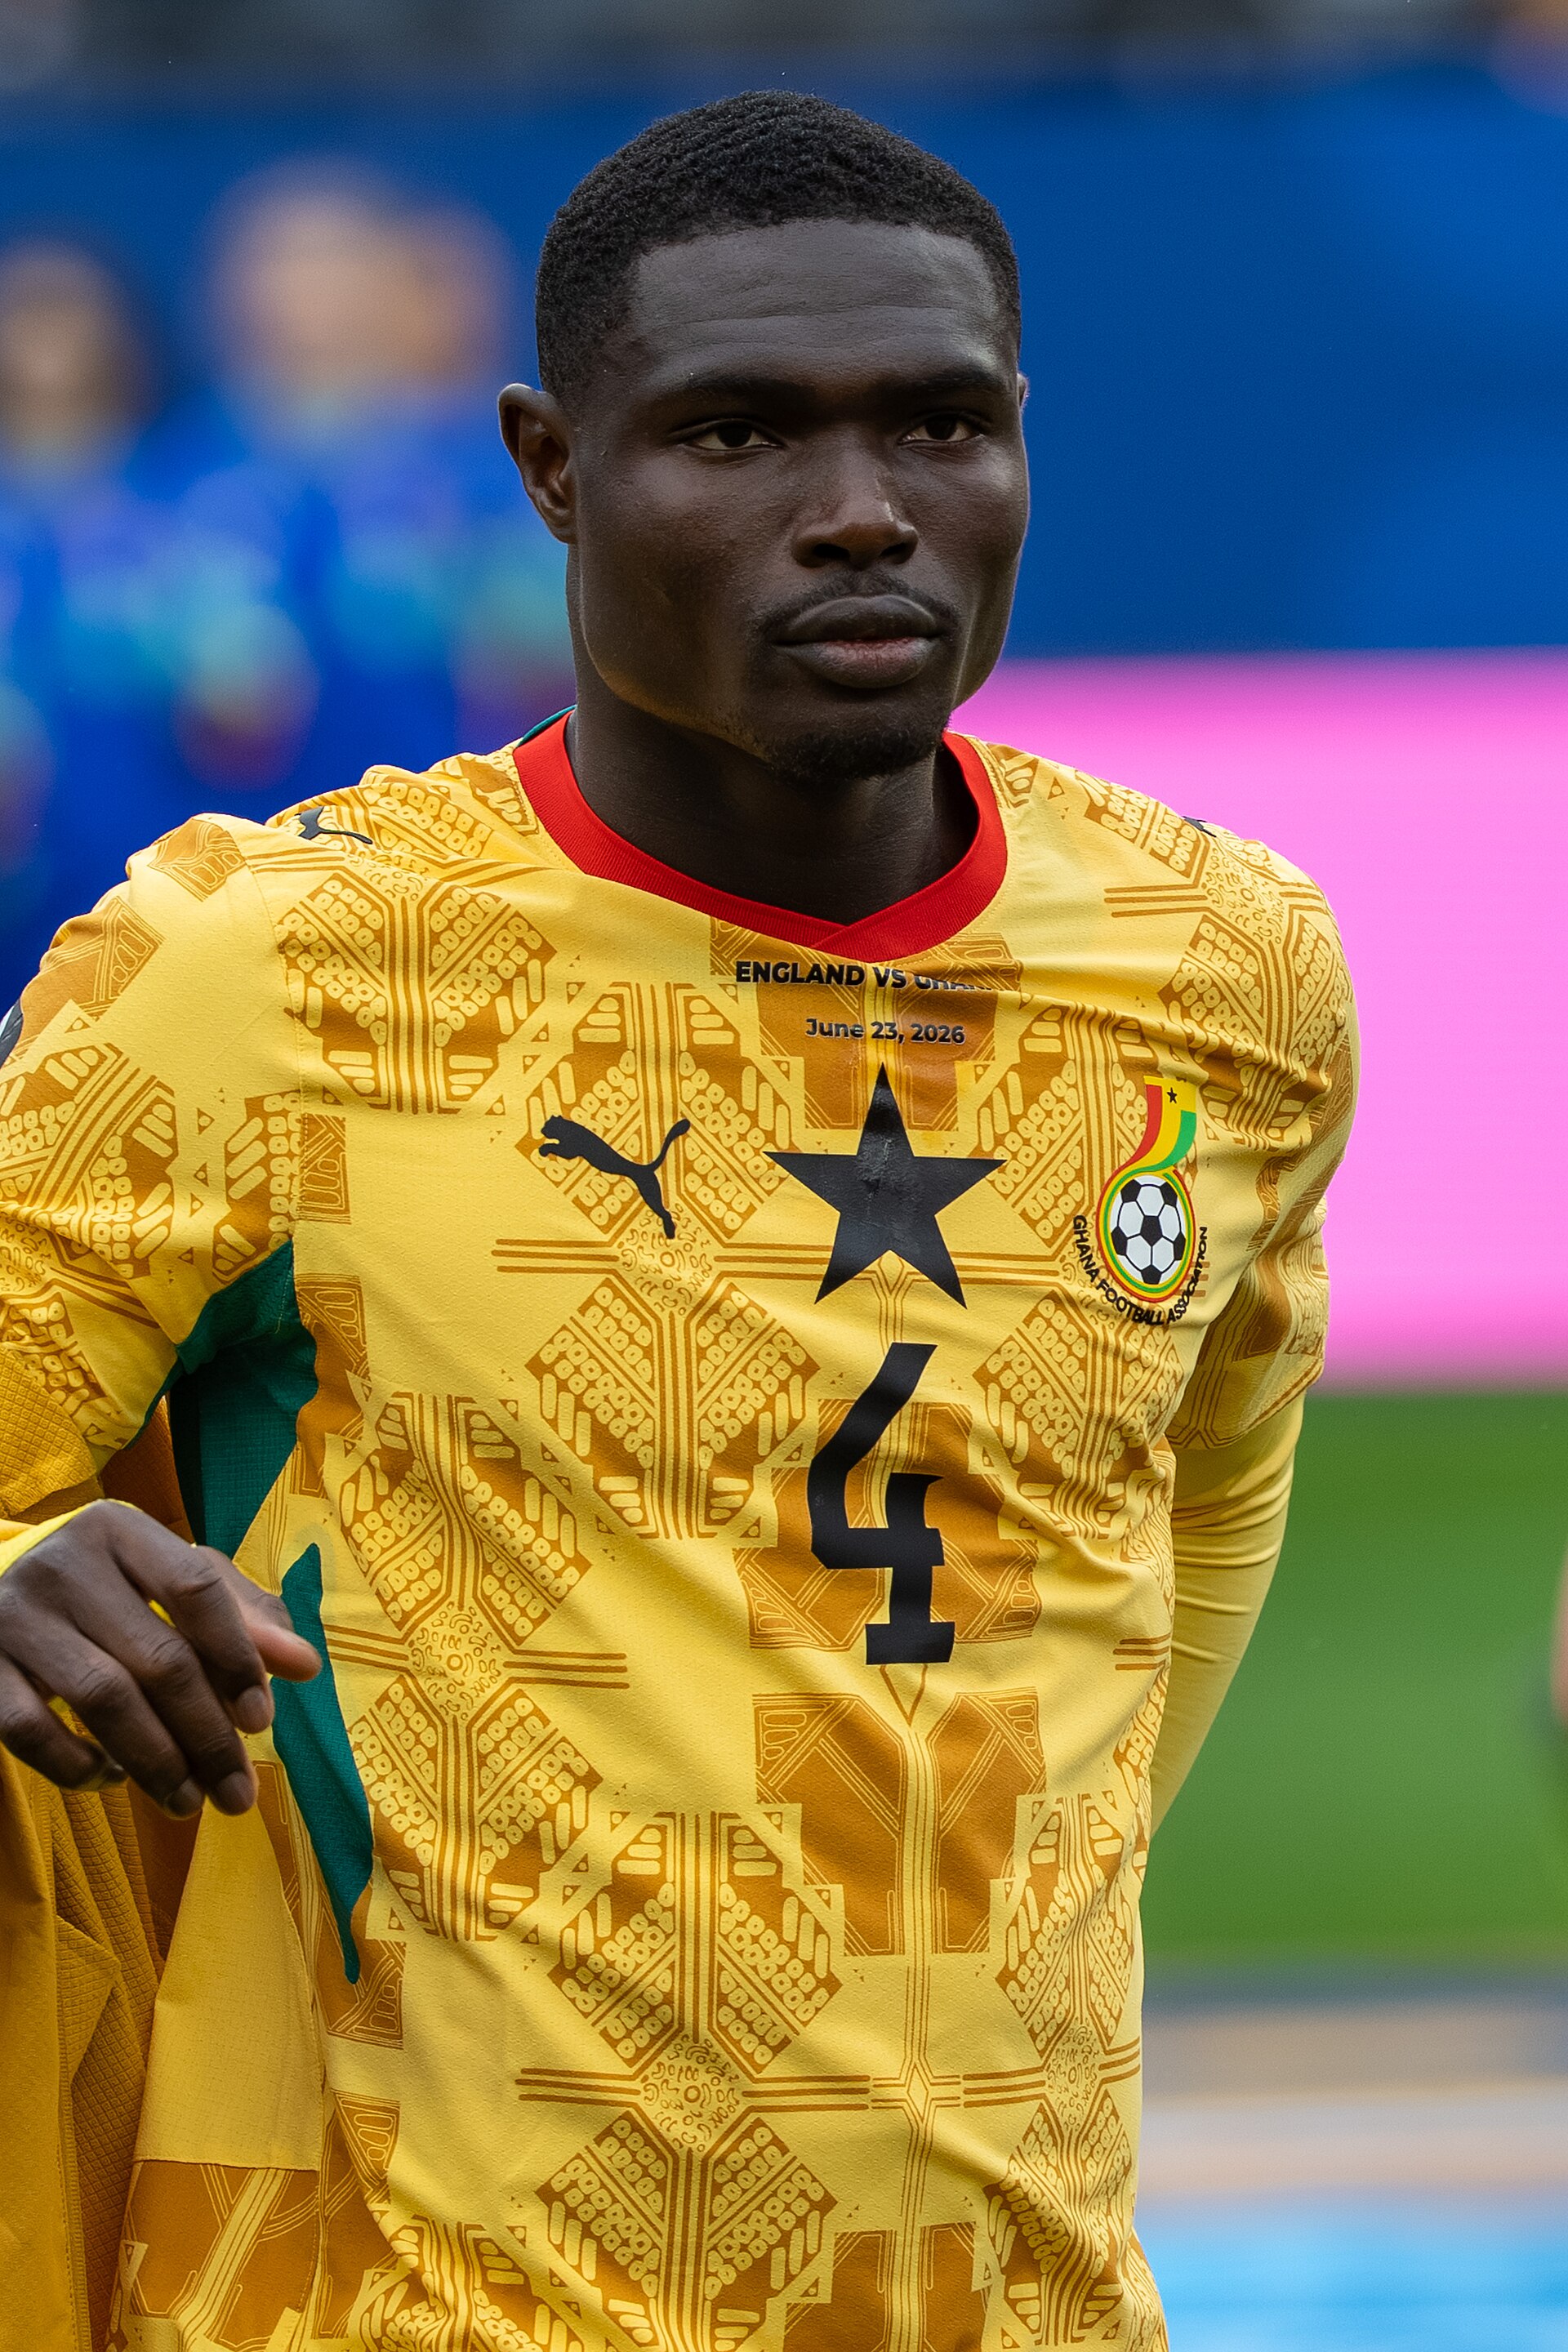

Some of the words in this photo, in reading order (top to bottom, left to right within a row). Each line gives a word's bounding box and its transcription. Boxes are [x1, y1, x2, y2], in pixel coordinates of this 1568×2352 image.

[736, 960, 866, 987] ENGLAND
[872, 966, 907, 989] VS
[805, 1018, 864, 1040] June
[871, 1022, 905, 1045] 23,
[911, 1023, 967, 1045] 2026
[1073, 1214, 1100, 1283] GHANA
[1095, 1278, 1165, 1326] FOOTBALL
[807, 1342, 956, 1665] 4
